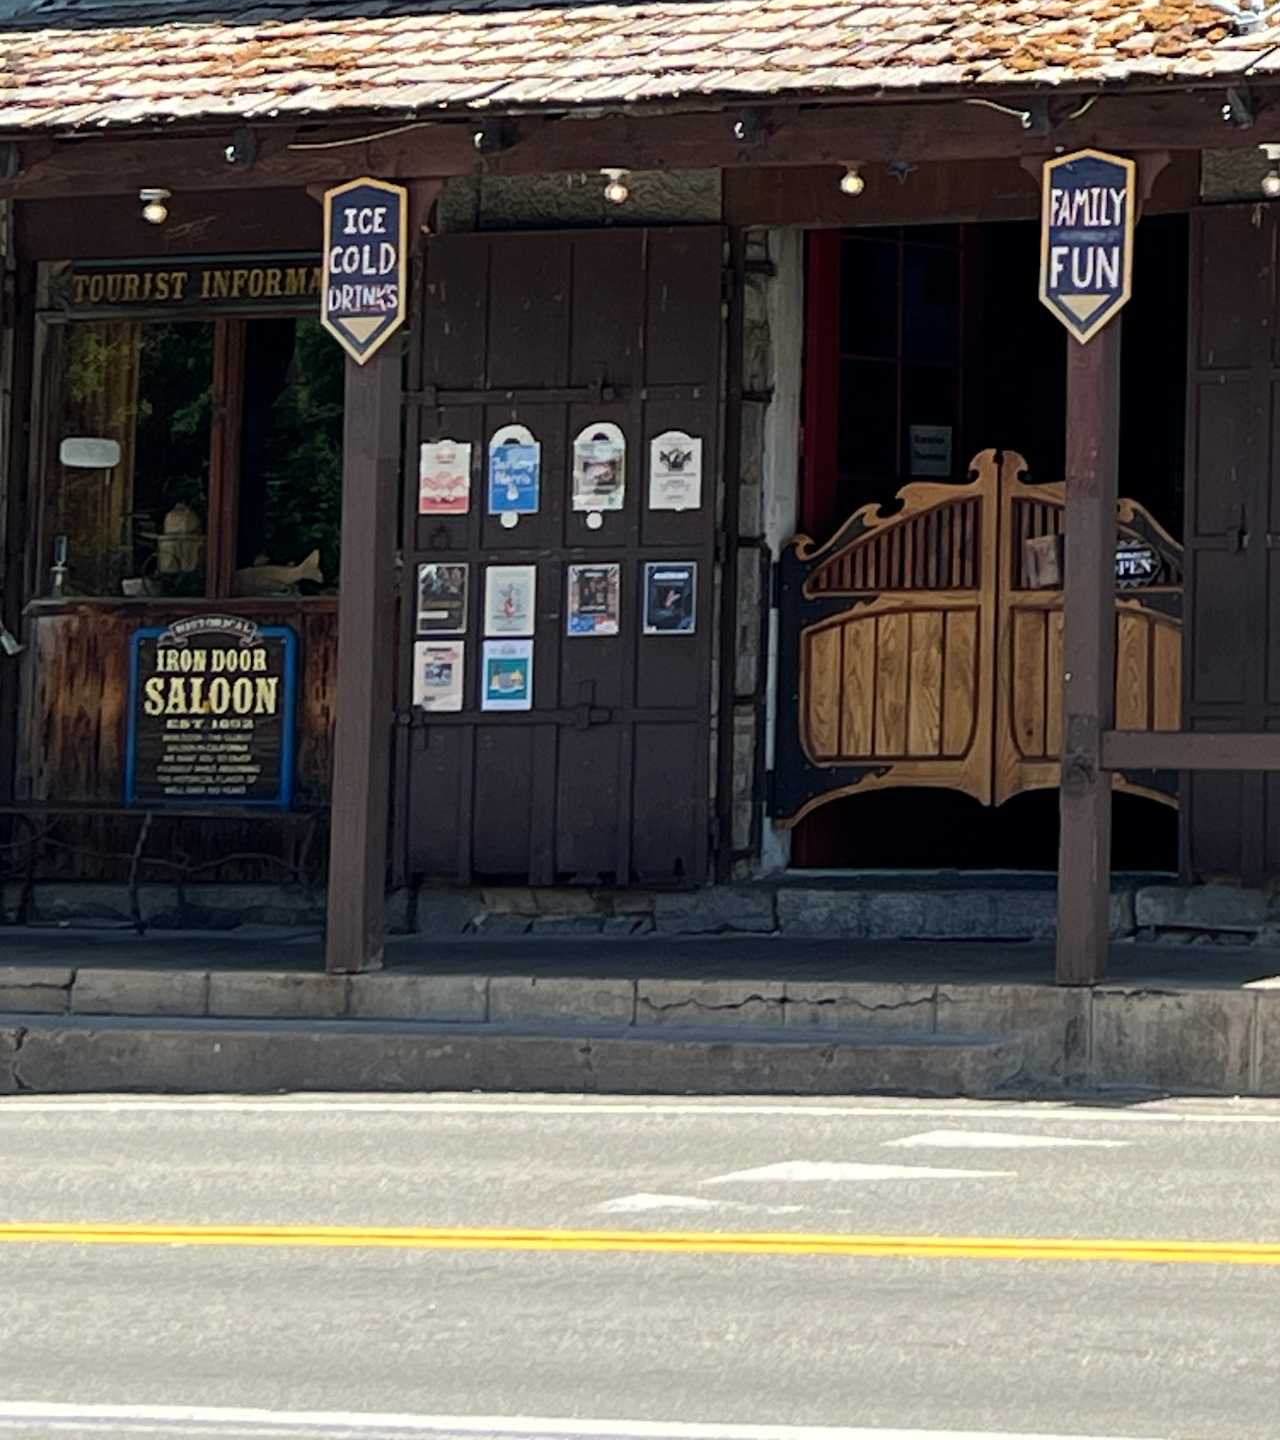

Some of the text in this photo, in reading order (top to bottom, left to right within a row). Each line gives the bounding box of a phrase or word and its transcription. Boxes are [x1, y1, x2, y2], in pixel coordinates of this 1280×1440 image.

[342, 206, 387, 235] ICE
[1050, 186, 1128, 227] FAMILY
[329, 242, 397, 276] COLD
[1049, 246, 1120, 290] FUN
[74, 271, 187, 304] TOURIST
[327, 283, 398, 312] DRINKS
[1114, 558, 1152, 576] PEN
[156, 648, 267, 672] IRON DOOR
[143, 676, 279, 716] SALOON
